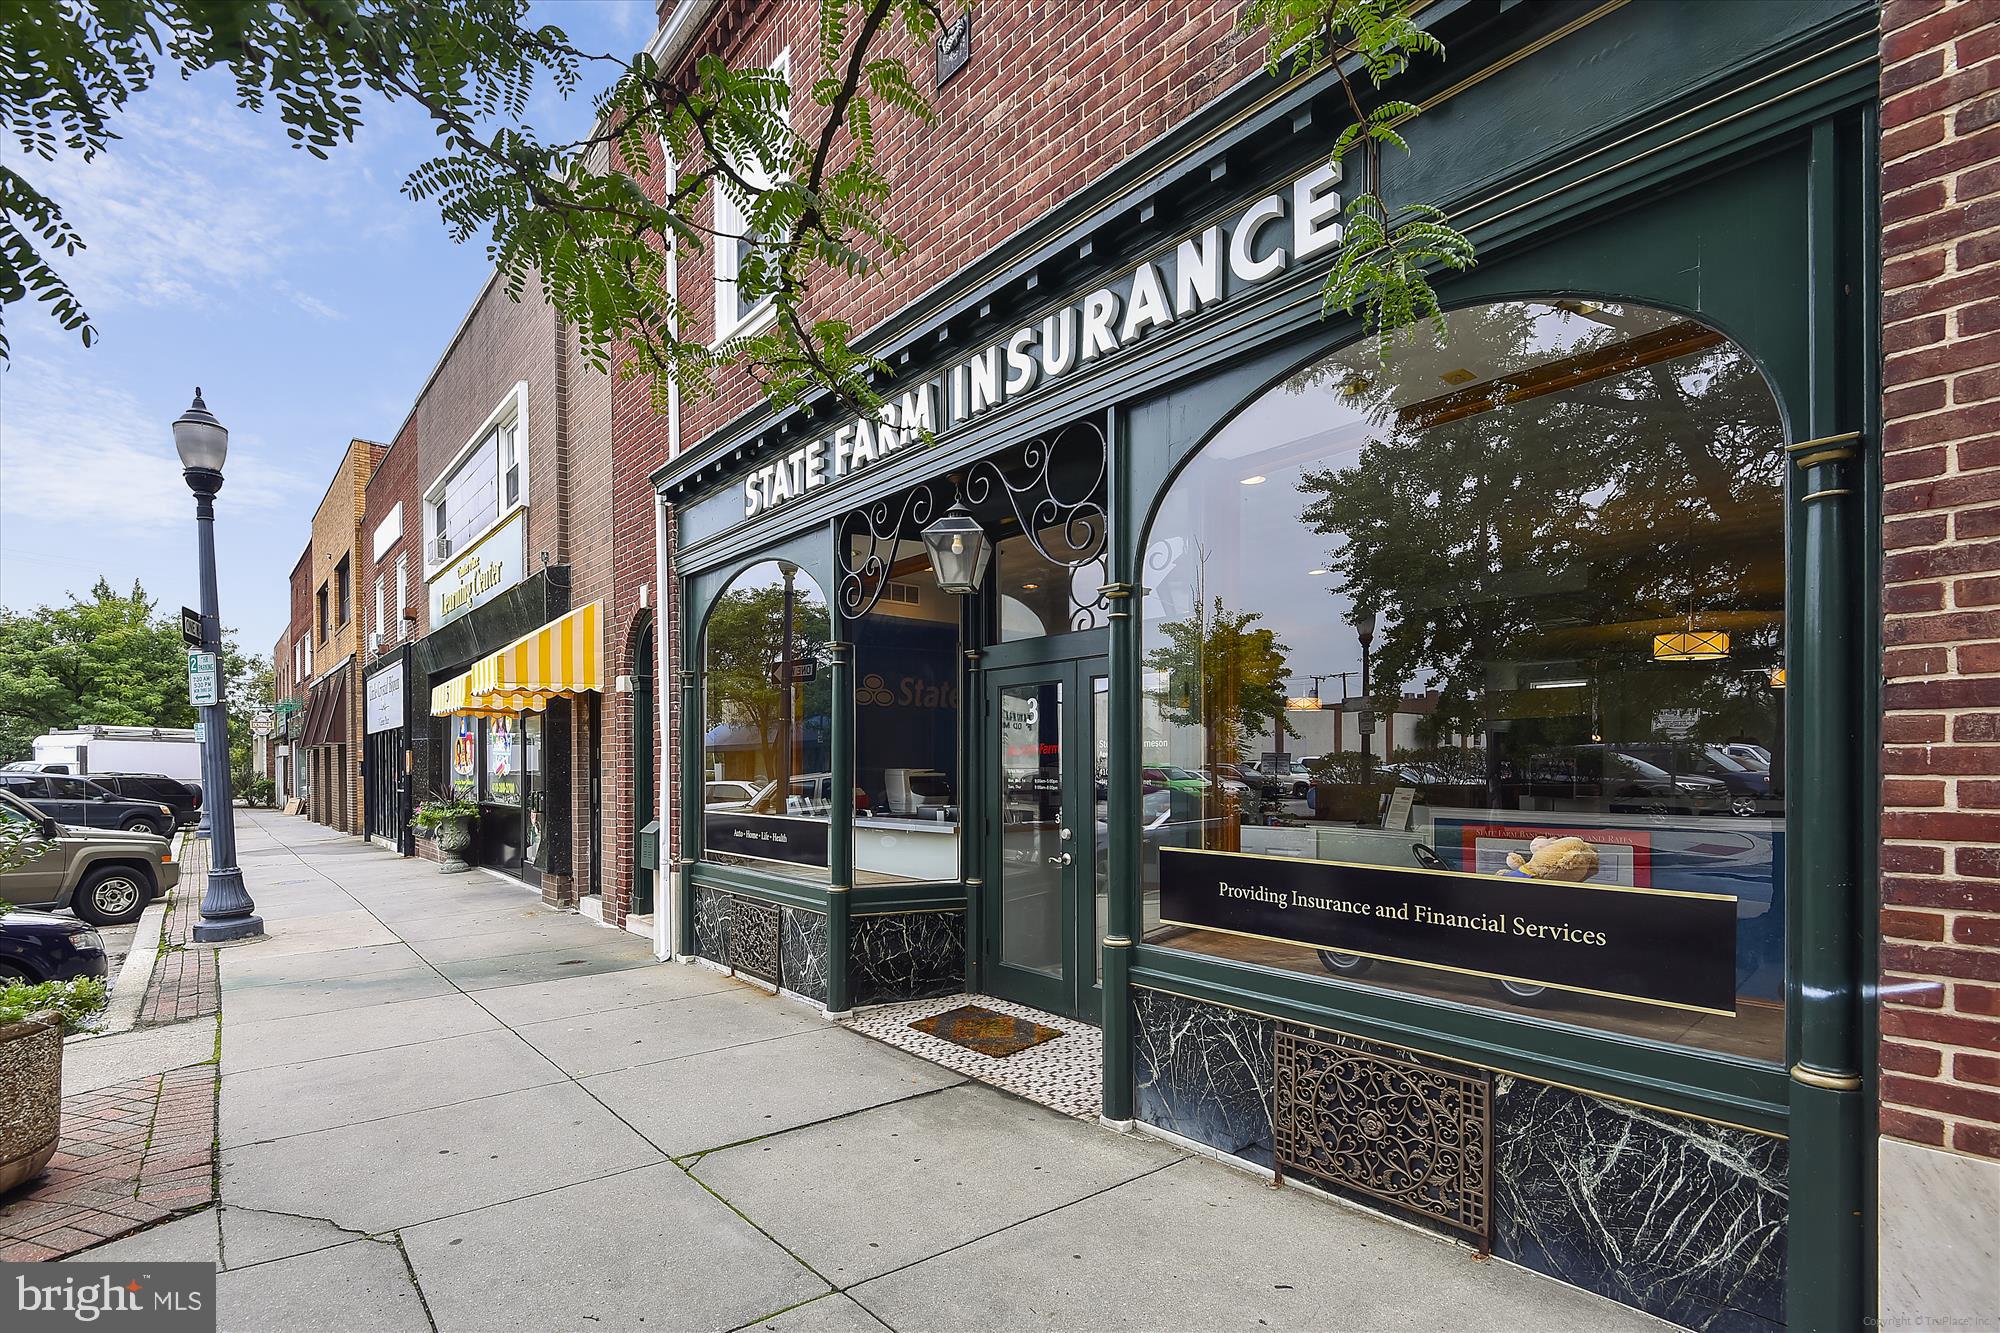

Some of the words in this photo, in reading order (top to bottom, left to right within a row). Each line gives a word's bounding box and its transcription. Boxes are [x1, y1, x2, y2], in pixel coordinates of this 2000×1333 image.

[745, 440, 826, 517] STATE
[834, 383, 937, 477] FARM
[954, 162, 1343, 422] INSURANCE
[474, 560, 503, 597] Center
[190, 657, 197, 671] 2
[1026, 697, 1039, 725] 3
[733, 829, 744, 838] Auto
[745, 829, 759, 840] Home
[760, 831, 770, 841] Life
[772, 832, 788, 843] Health
[1475, 829, 1496, 837] STATE
[1498, 829, 1517, 838] FARM
[1588, 834, 1605, 842] AND
[1608, 835, 1633, 843] RATES
[1218, 881, 1288, 909] Providing
[1291, 890, 1371, 916] Insurance
[1375, 902, 1409, 921] and
[1414, 904, 1507, 934] Financial
[1512, 916, 1607, 947] Services
